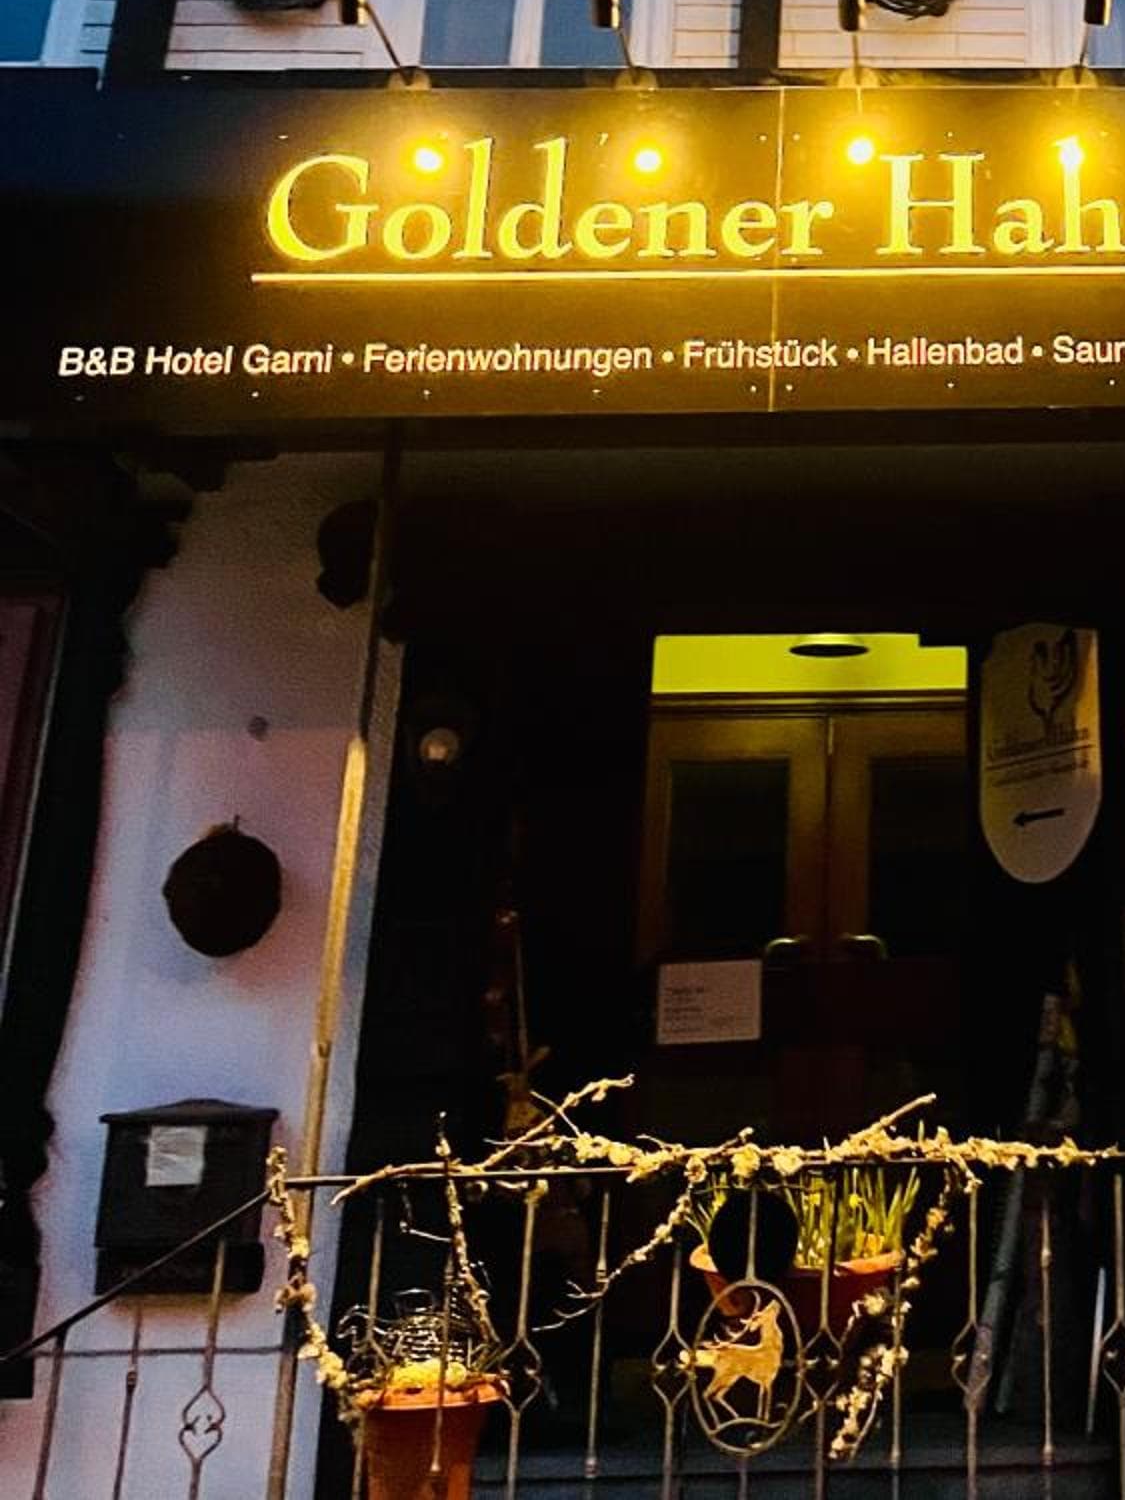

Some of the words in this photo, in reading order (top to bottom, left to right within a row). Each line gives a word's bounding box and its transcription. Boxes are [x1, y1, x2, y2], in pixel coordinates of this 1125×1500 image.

[266, 136, 835, 262] Goldener
[58, 346, 134, 377] B&B
[145, 345, 234, 374] Hotel
[242, 344, 333, 373] Garni
[363, 343, 652, 376] Ferienwohnungen
[683, 338, 839, 368] Frühstück
[867, 336, 1024, 365] Hallenbad
